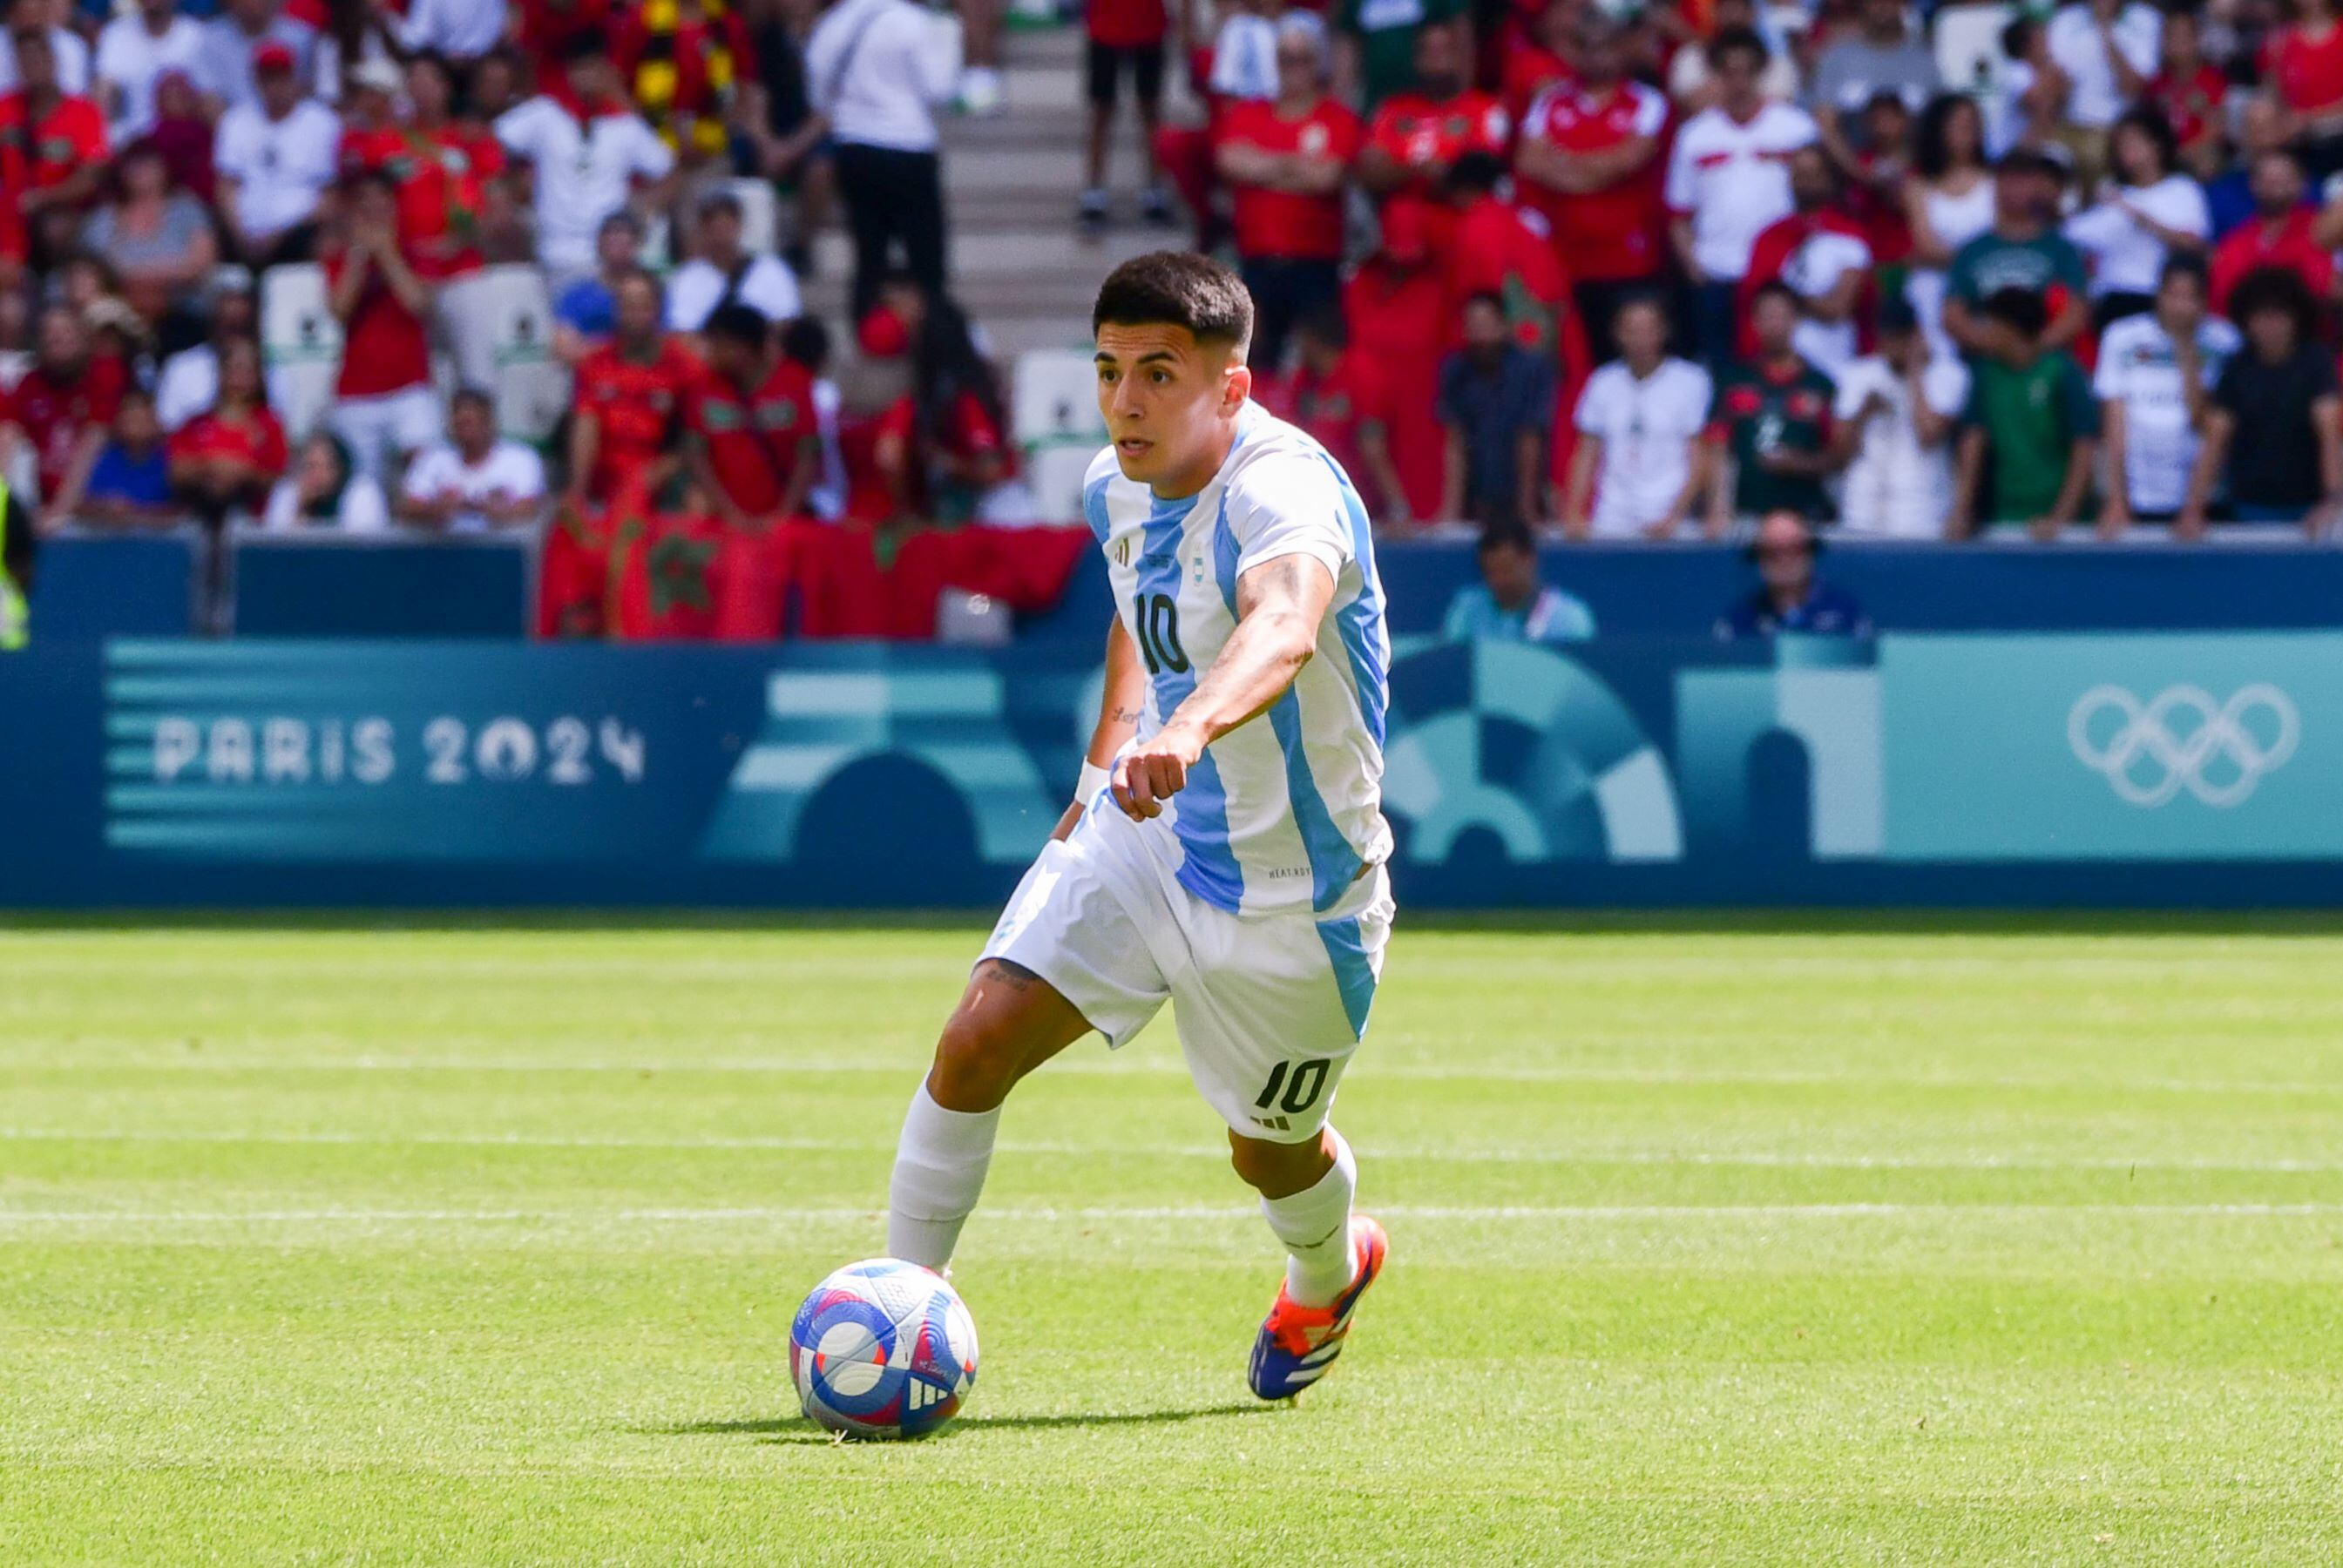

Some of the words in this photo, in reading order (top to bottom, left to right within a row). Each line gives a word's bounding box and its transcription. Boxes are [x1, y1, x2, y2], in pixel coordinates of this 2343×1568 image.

[1136, 593, 1189, 674] 10
[153, 716, 395, 782] PARIS
[422, 716, 647, 783] 2024
[1255, 1058, 1331, 1113] 10
